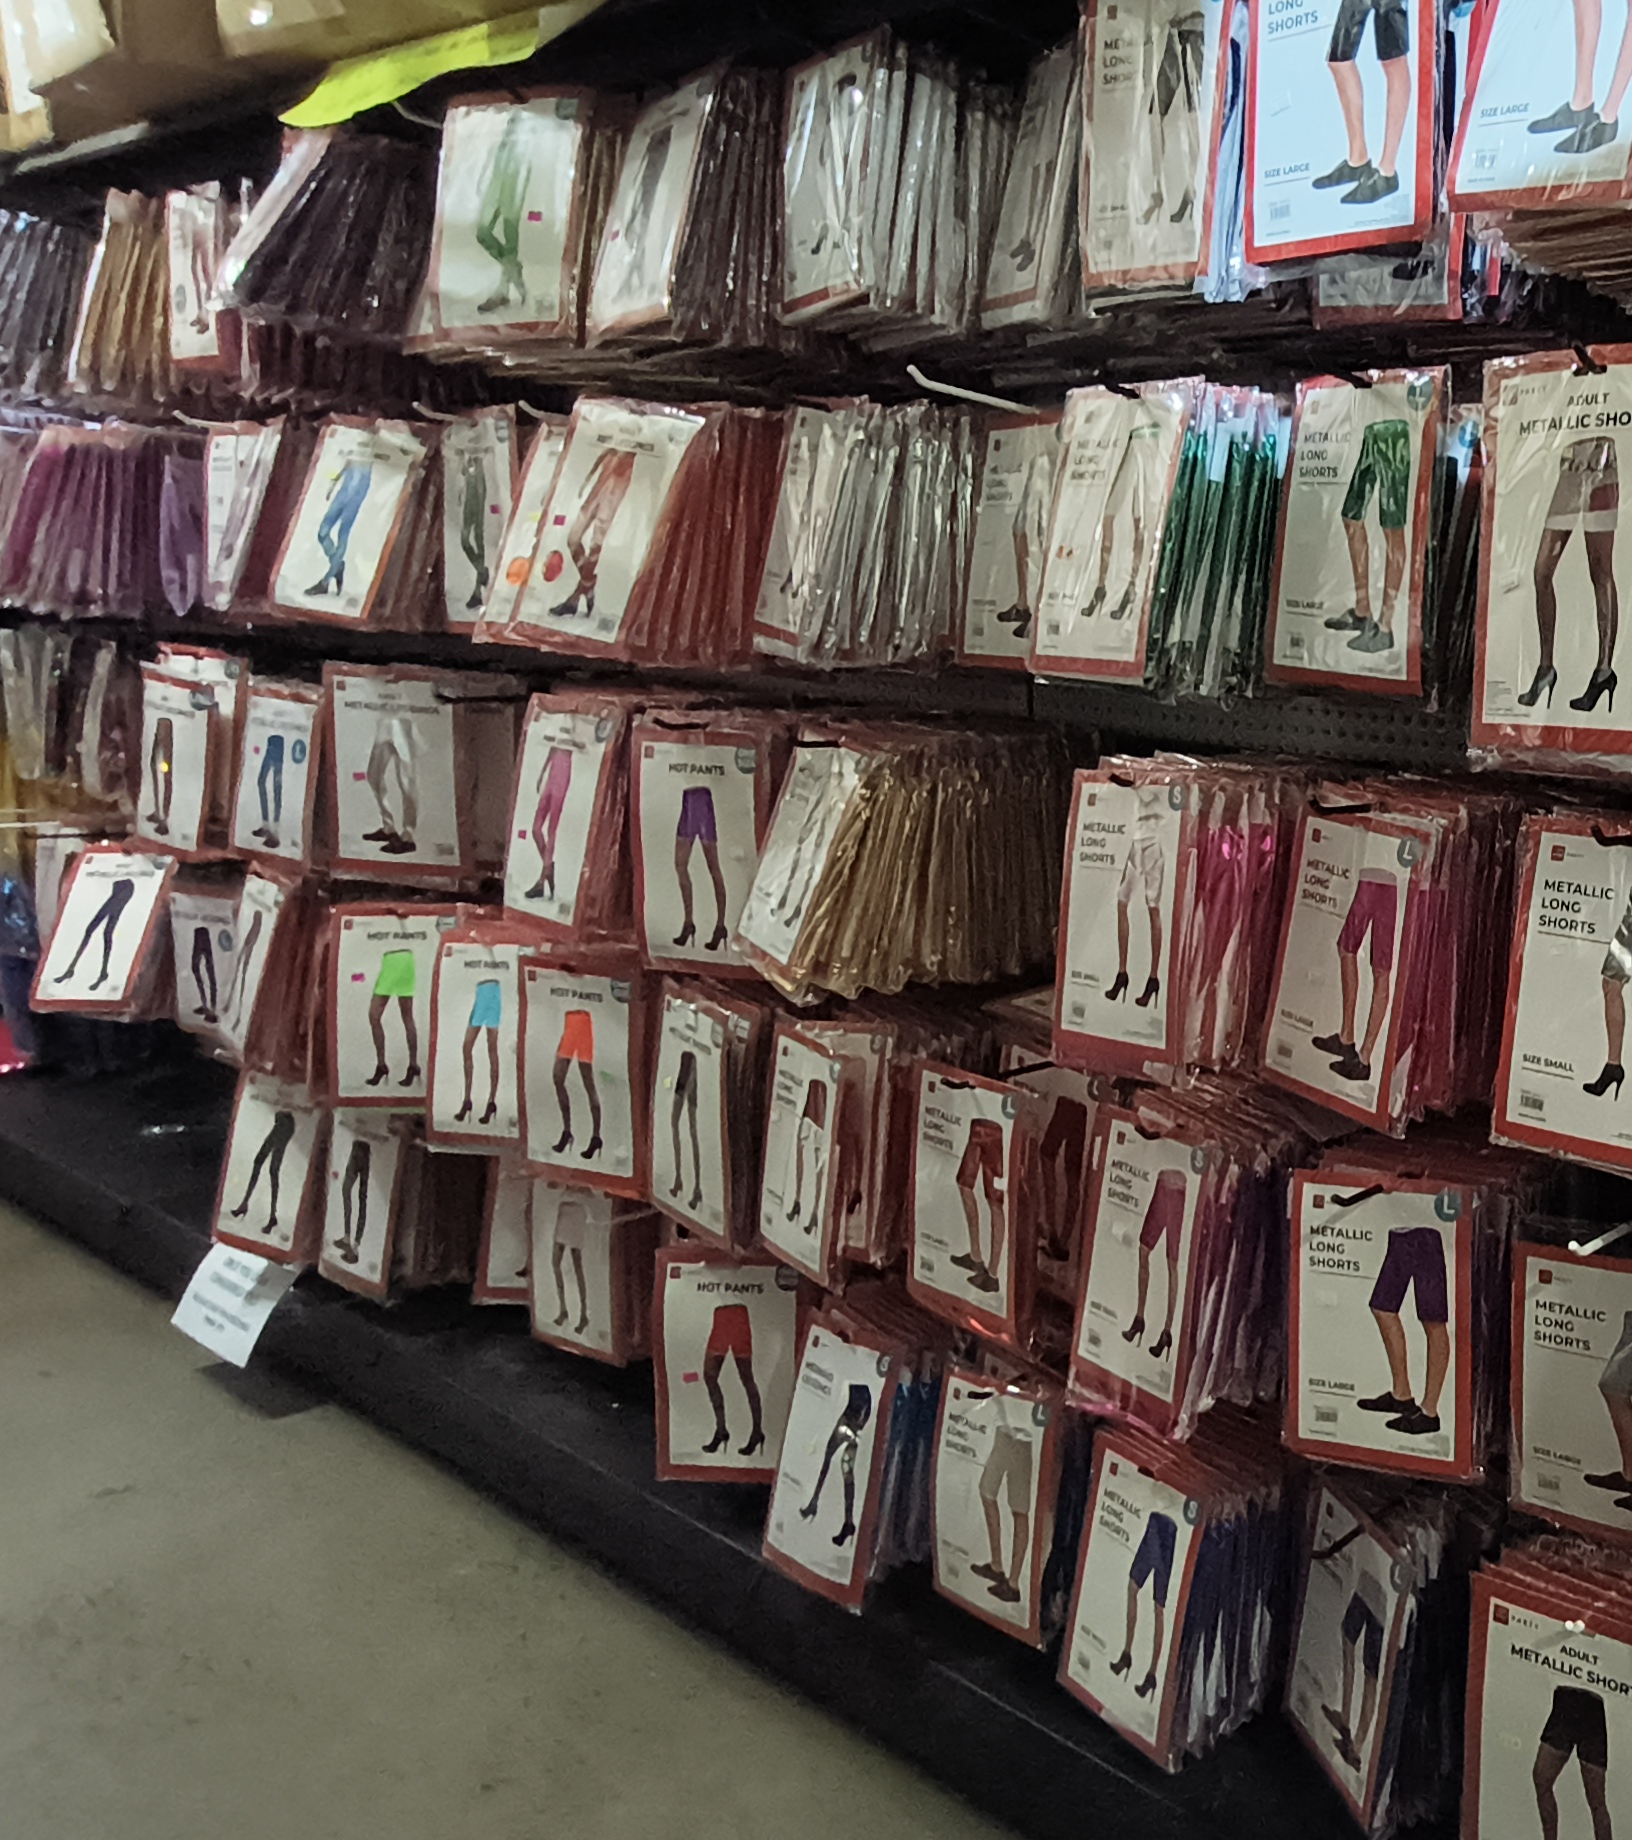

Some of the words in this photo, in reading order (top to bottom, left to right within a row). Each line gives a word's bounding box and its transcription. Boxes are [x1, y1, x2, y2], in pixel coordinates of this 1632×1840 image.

[1268, 10, 1318, 34] SHORTS
[1480, 106, 1498, 118] SIZE
[1500, 102, 1530, 117] LARGE
[1283, 163, 1310, 176] LARGE
[1519, 413, 1591, 436] METALLIC
[1083, 821, 1127, 836] METALLIC
[1403, 841, 1413, 860] L
[1544, 879, 1615, 900] METALLIC
[1541, 897, 1582, 914] LONG
[1538, 915, 1596, 935] SHORTS
[1522, 1053, 1542, 1067] SIZE
[1543, 1057, 1575, 1073] SMALL
[1443, 1194, 1455, 1215] L
[1309, 1224, 1373, 1242] METALLIC
[1309, 1241, 1346, 1255] LONG
[1309, 1256, 1361, 1273] SHORTS
[1535, 1299, 1607, 1323] METALLIC
[1534, 1315, 1575, 1333] LONG
[1533, 1329, 1592, 1352] SHORTS
[1511, 1643, 1584, 1680] METALLIC
[1559, 1645, 1599, 1666] ADULT
